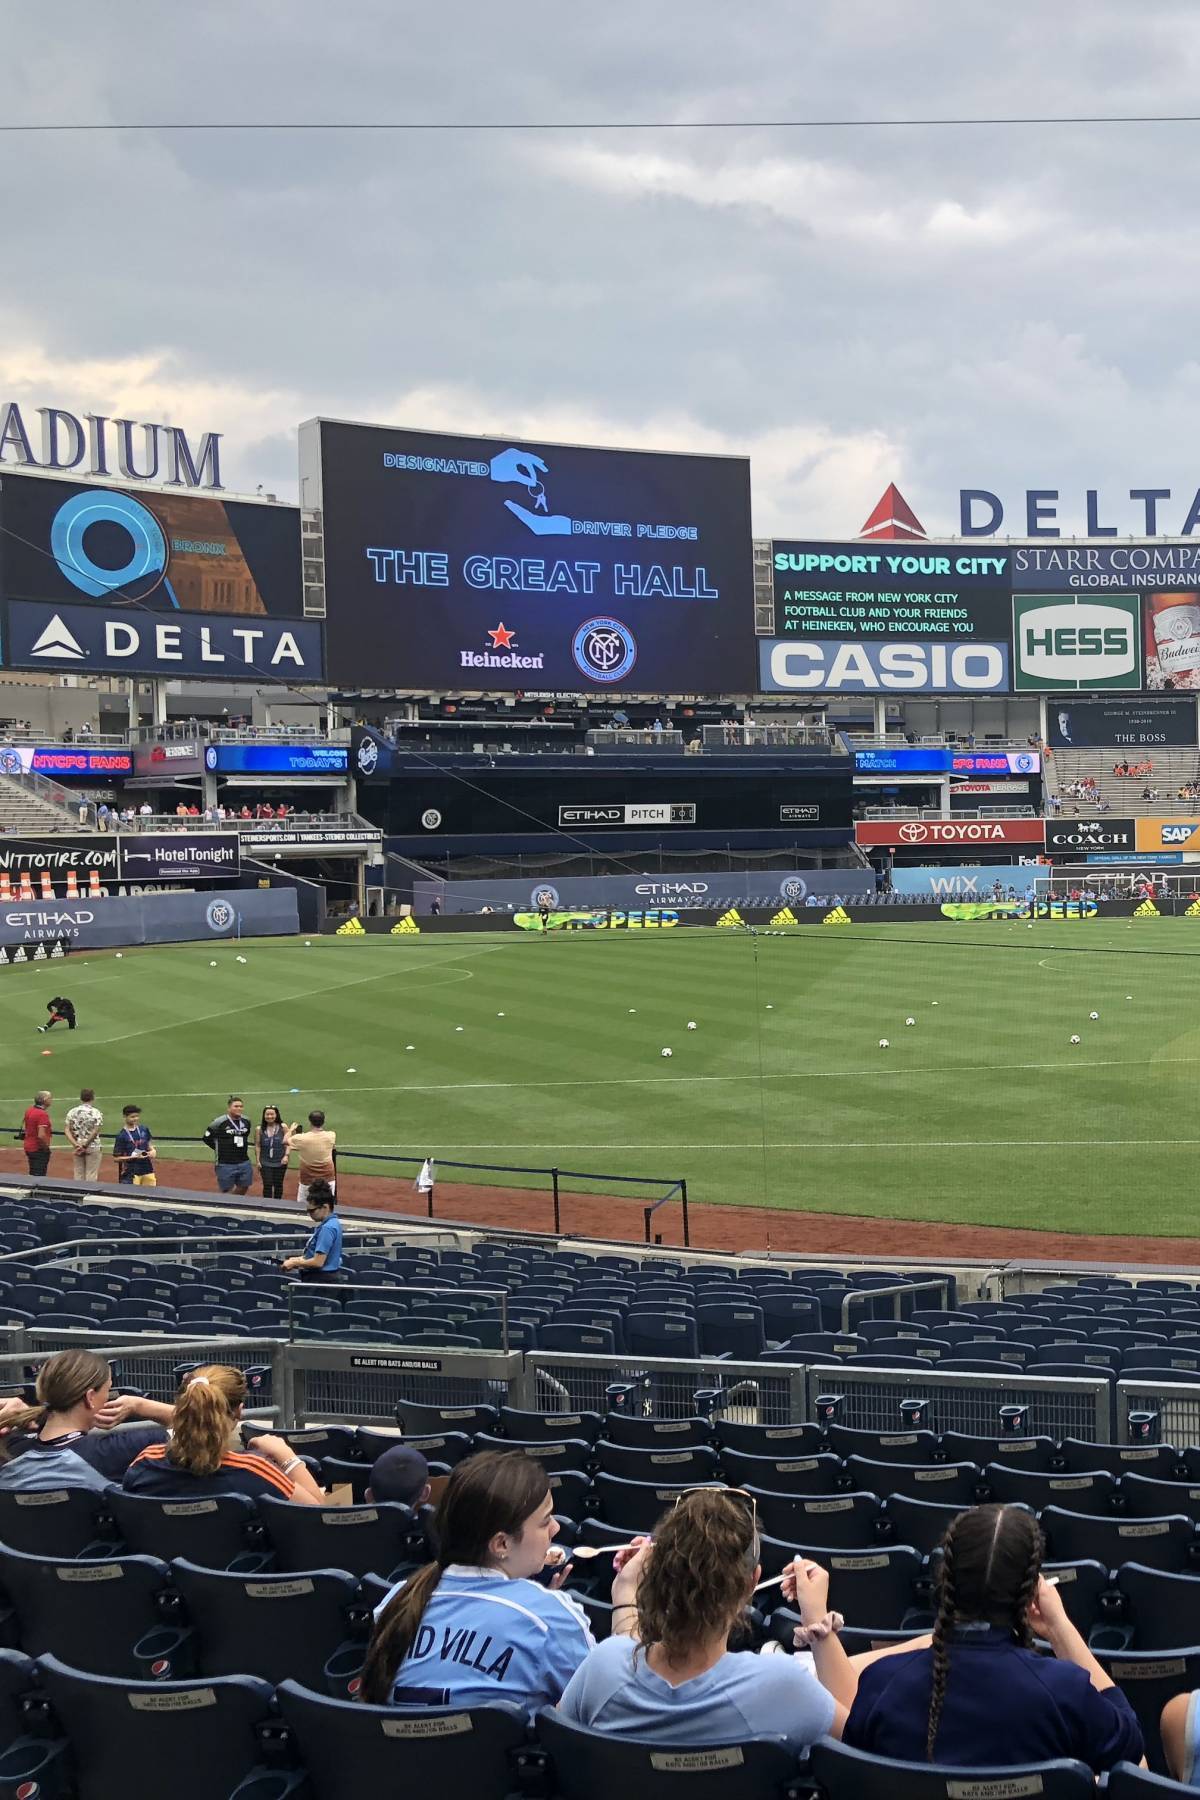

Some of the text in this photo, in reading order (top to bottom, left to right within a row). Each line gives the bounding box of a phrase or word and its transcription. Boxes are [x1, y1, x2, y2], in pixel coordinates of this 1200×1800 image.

[0, 402, 225, 489] ADIUM
[383, 453, 489, 476] DESIGNATED
[572, 520, 698, 540] DRIVER PLEDGE
[172, 539, 226, 555] BRONX
[774, 553, 1007, 575] SUPPORT YOUR CITY
[1015, 549, 1102, 572] STARR
[367, 548, 718, 599] THE GREAT HALL
[1069, 573, 1128, 587] GLOBAL
[784, 591, 958, 604] A MESSAGE FROM NEW YORK CITY
[784, 606, 968, 619] FOOTBALL CLUB AND YOUR FRIENDS
[784, 620, 974, 632] AT HEINEKEN, WHO ENCOURAGE YOU
[105, 621, 304, 666] DELTA
[1026, 627, 1128, 656] HESS
[460, 651, 544, 669] Heineken
[770, 642, 1003, 689] CASIO
[1115, 733, 1166, 743] THE BOSS
[33, 755, 130, 769] NYCFC FANS
[289, 757, 343, 768] TODAY'S
[960, 784, 991, 792] TOYOTA
[563, 809, 664, 820] ETIHAD PITCH
[930, 824, 1005, 839] TOYOTA
[1052, 833, 1128, 844] COACH
[1162, 827, 1192, 841] SAP
[0, 850, 116, 868] NITTOTIRE.COM
[1018, 854, 1053, 866] FedEx
[635, 882, 708, 895] ETIHAD
[5, 911, 94, 926] ETIHAD
[24, 928, 80, 939] AIRWAYS
[440, 1627, 514, 1682] VILLA
